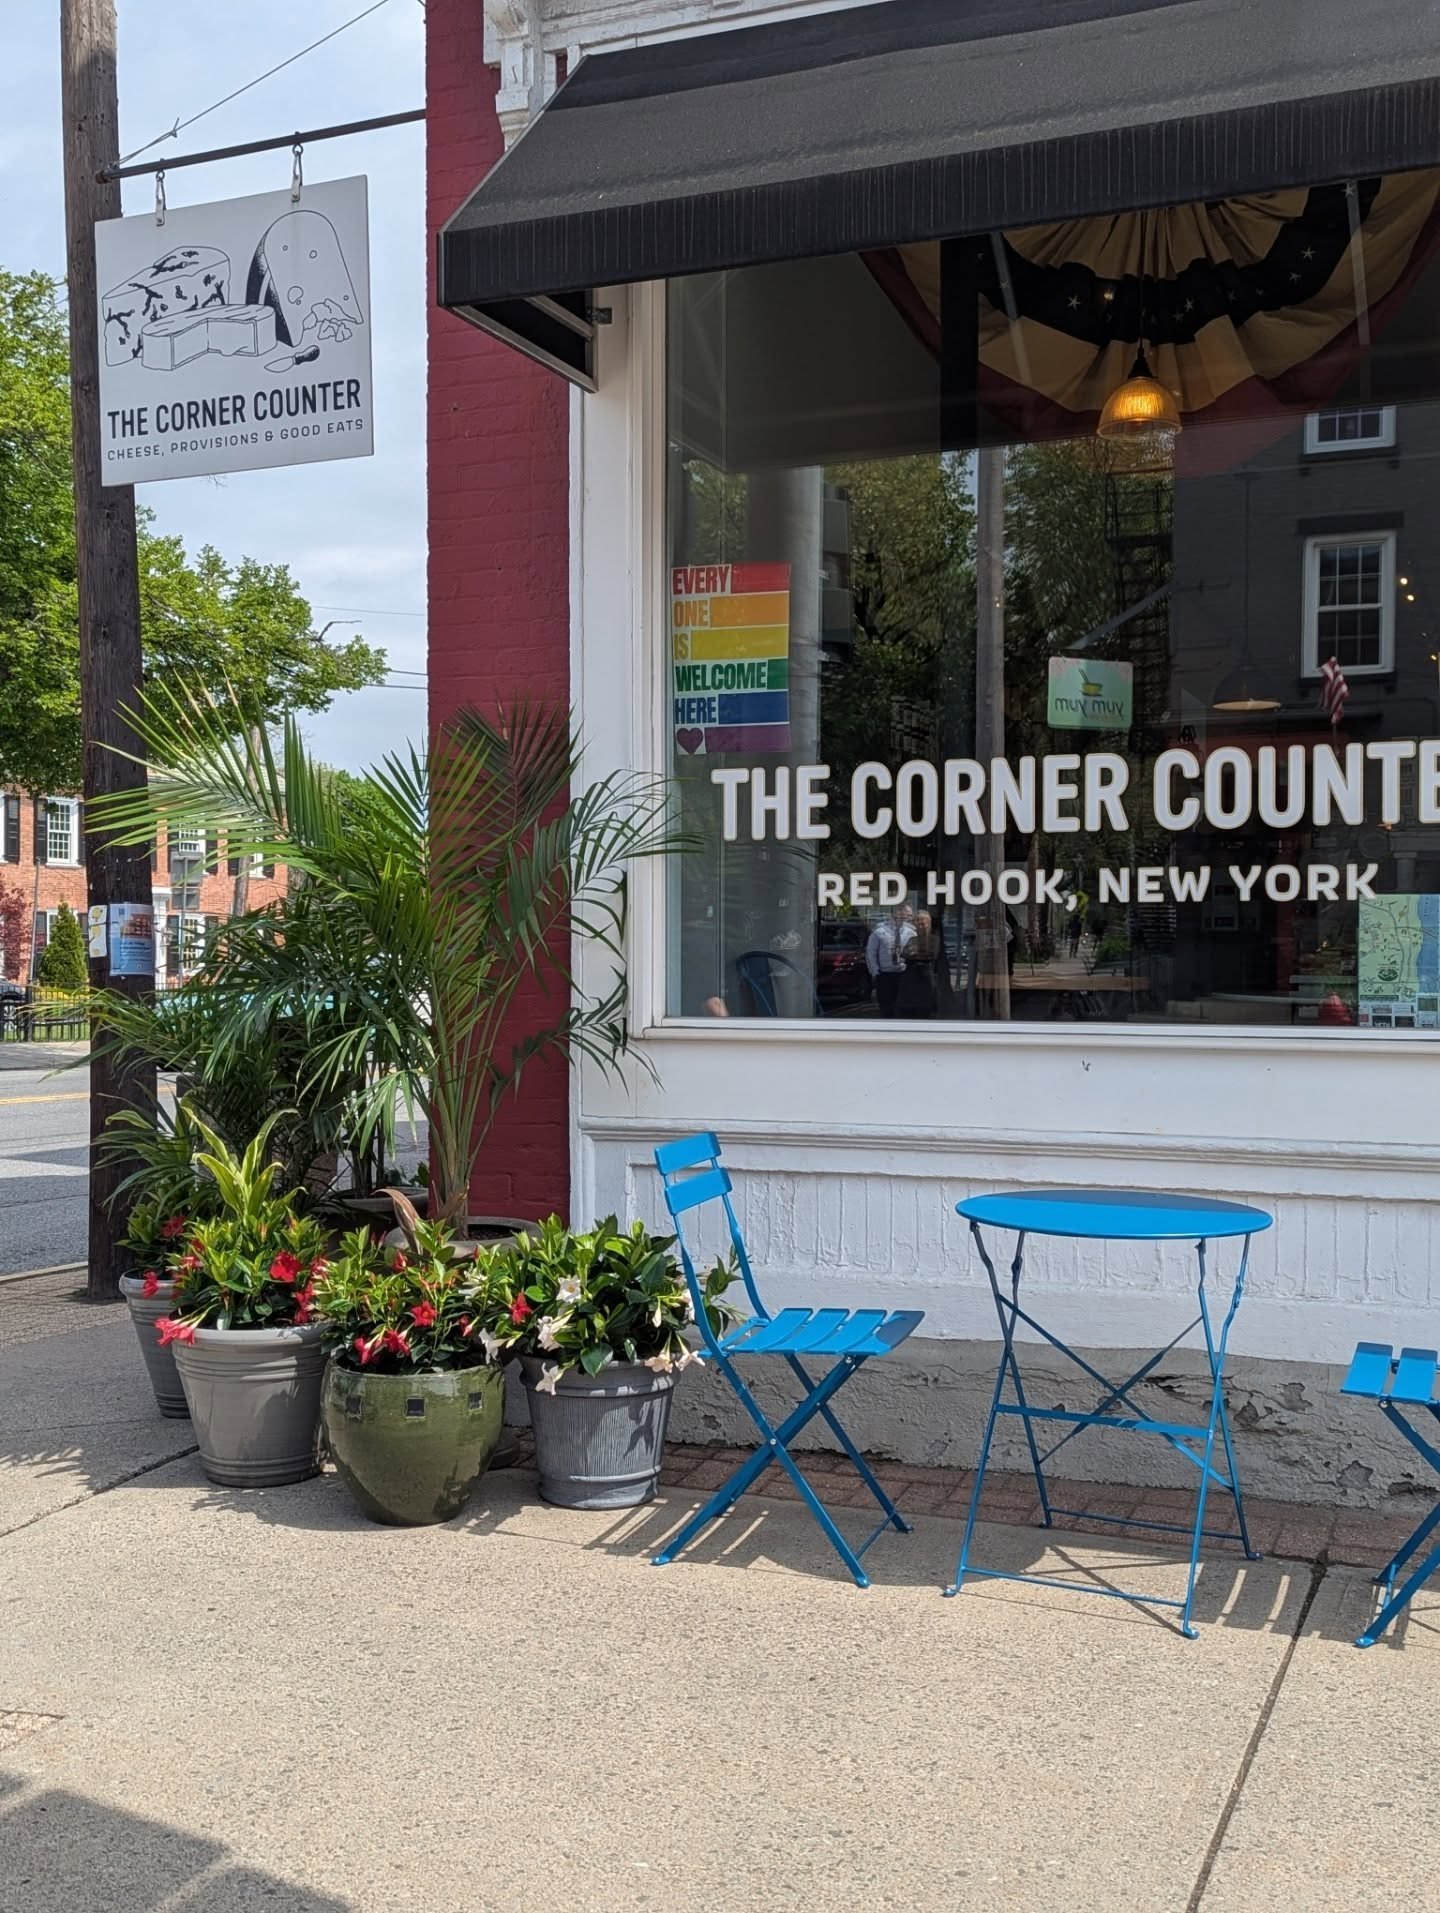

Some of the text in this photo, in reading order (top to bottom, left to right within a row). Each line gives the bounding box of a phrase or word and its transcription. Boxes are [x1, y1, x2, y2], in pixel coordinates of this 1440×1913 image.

[107, 378, 361, 439] THE CORNER COUNTER
[107, 418, 364, 461] CHEESE, PROVISIONS & GOOD EATS
[672, 566, 730, 595] EVERY
[673, 600, 709, 628] ONE
[674, 633, 689, 660] IS
[675, 662, 767, 692] WELCOME
[675, 697, 717, 725] HERE
[711, 740, 1440, 841] THE CORNER COUNTE
[817, 862, 1379, 912] RED HOOK, NEW YORK
